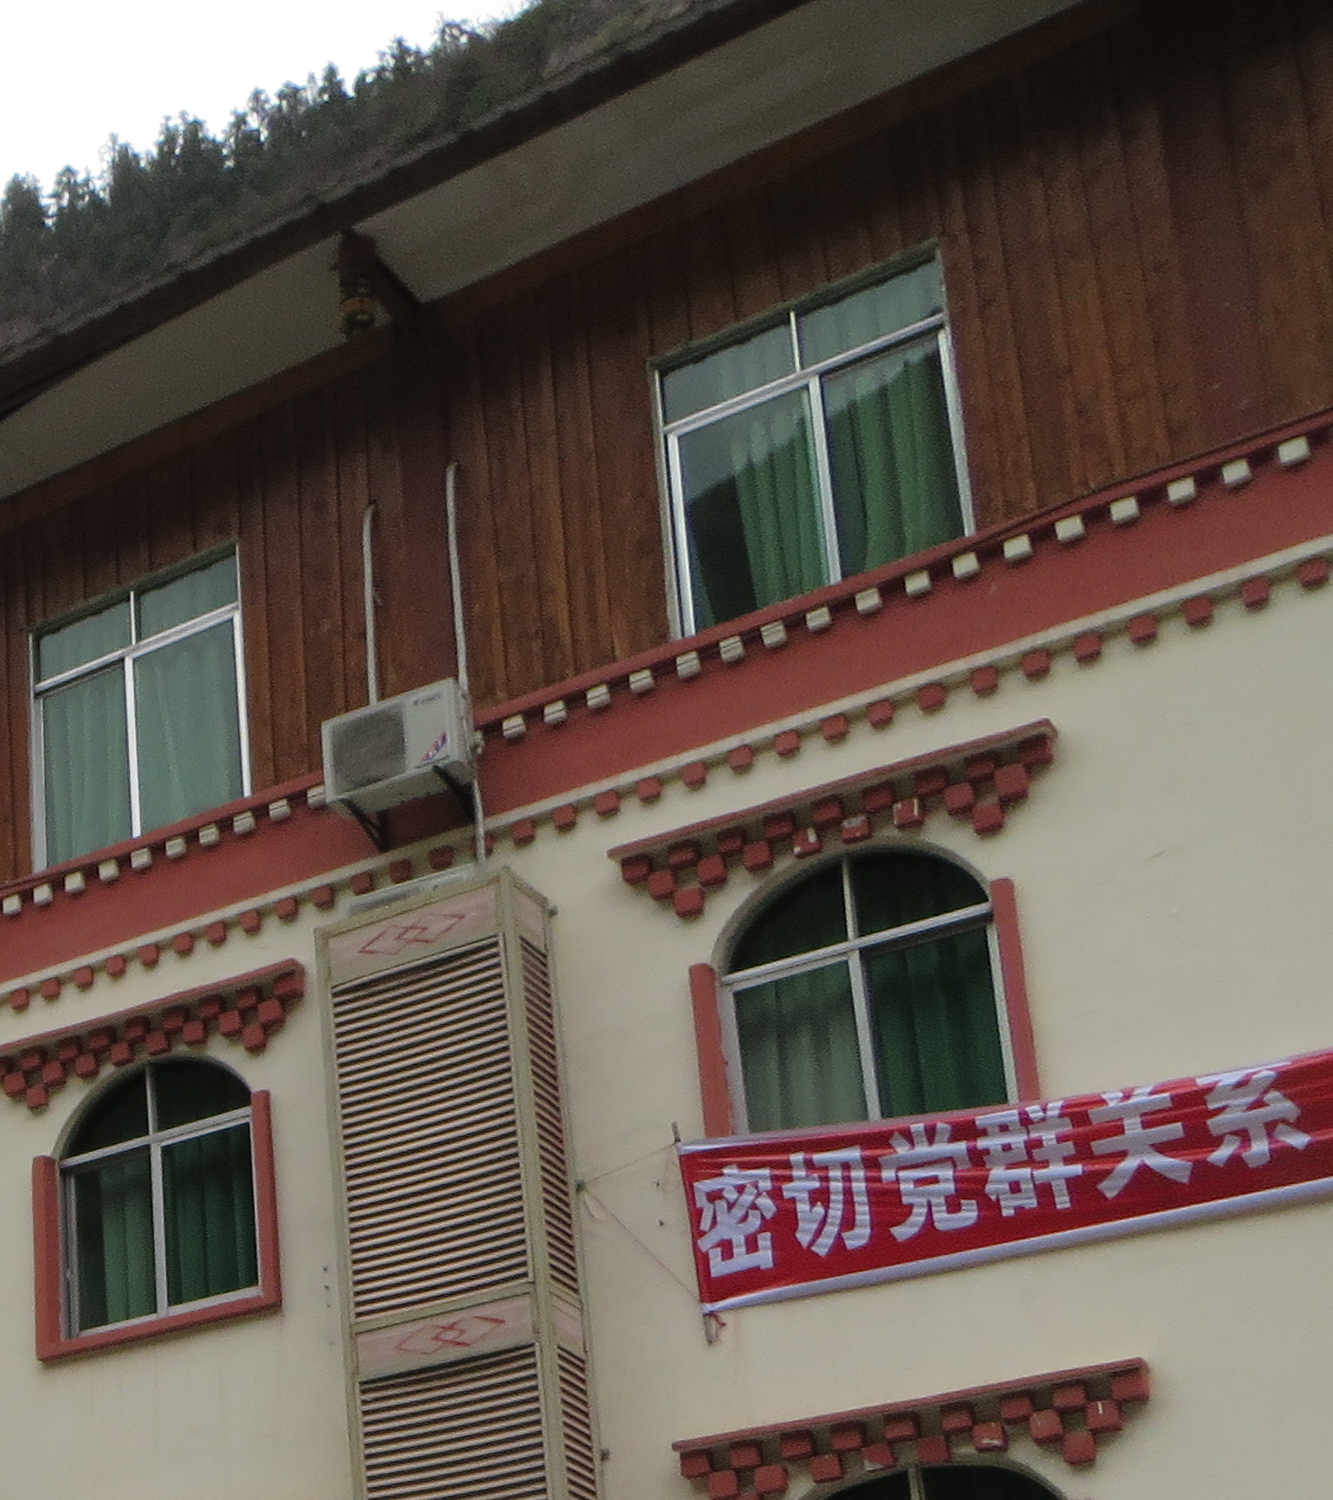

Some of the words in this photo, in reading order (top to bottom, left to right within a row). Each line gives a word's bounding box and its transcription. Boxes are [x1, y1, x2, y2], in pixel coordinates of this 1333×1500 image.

[692, 1069, 1312, 1280] 密切党群关系
